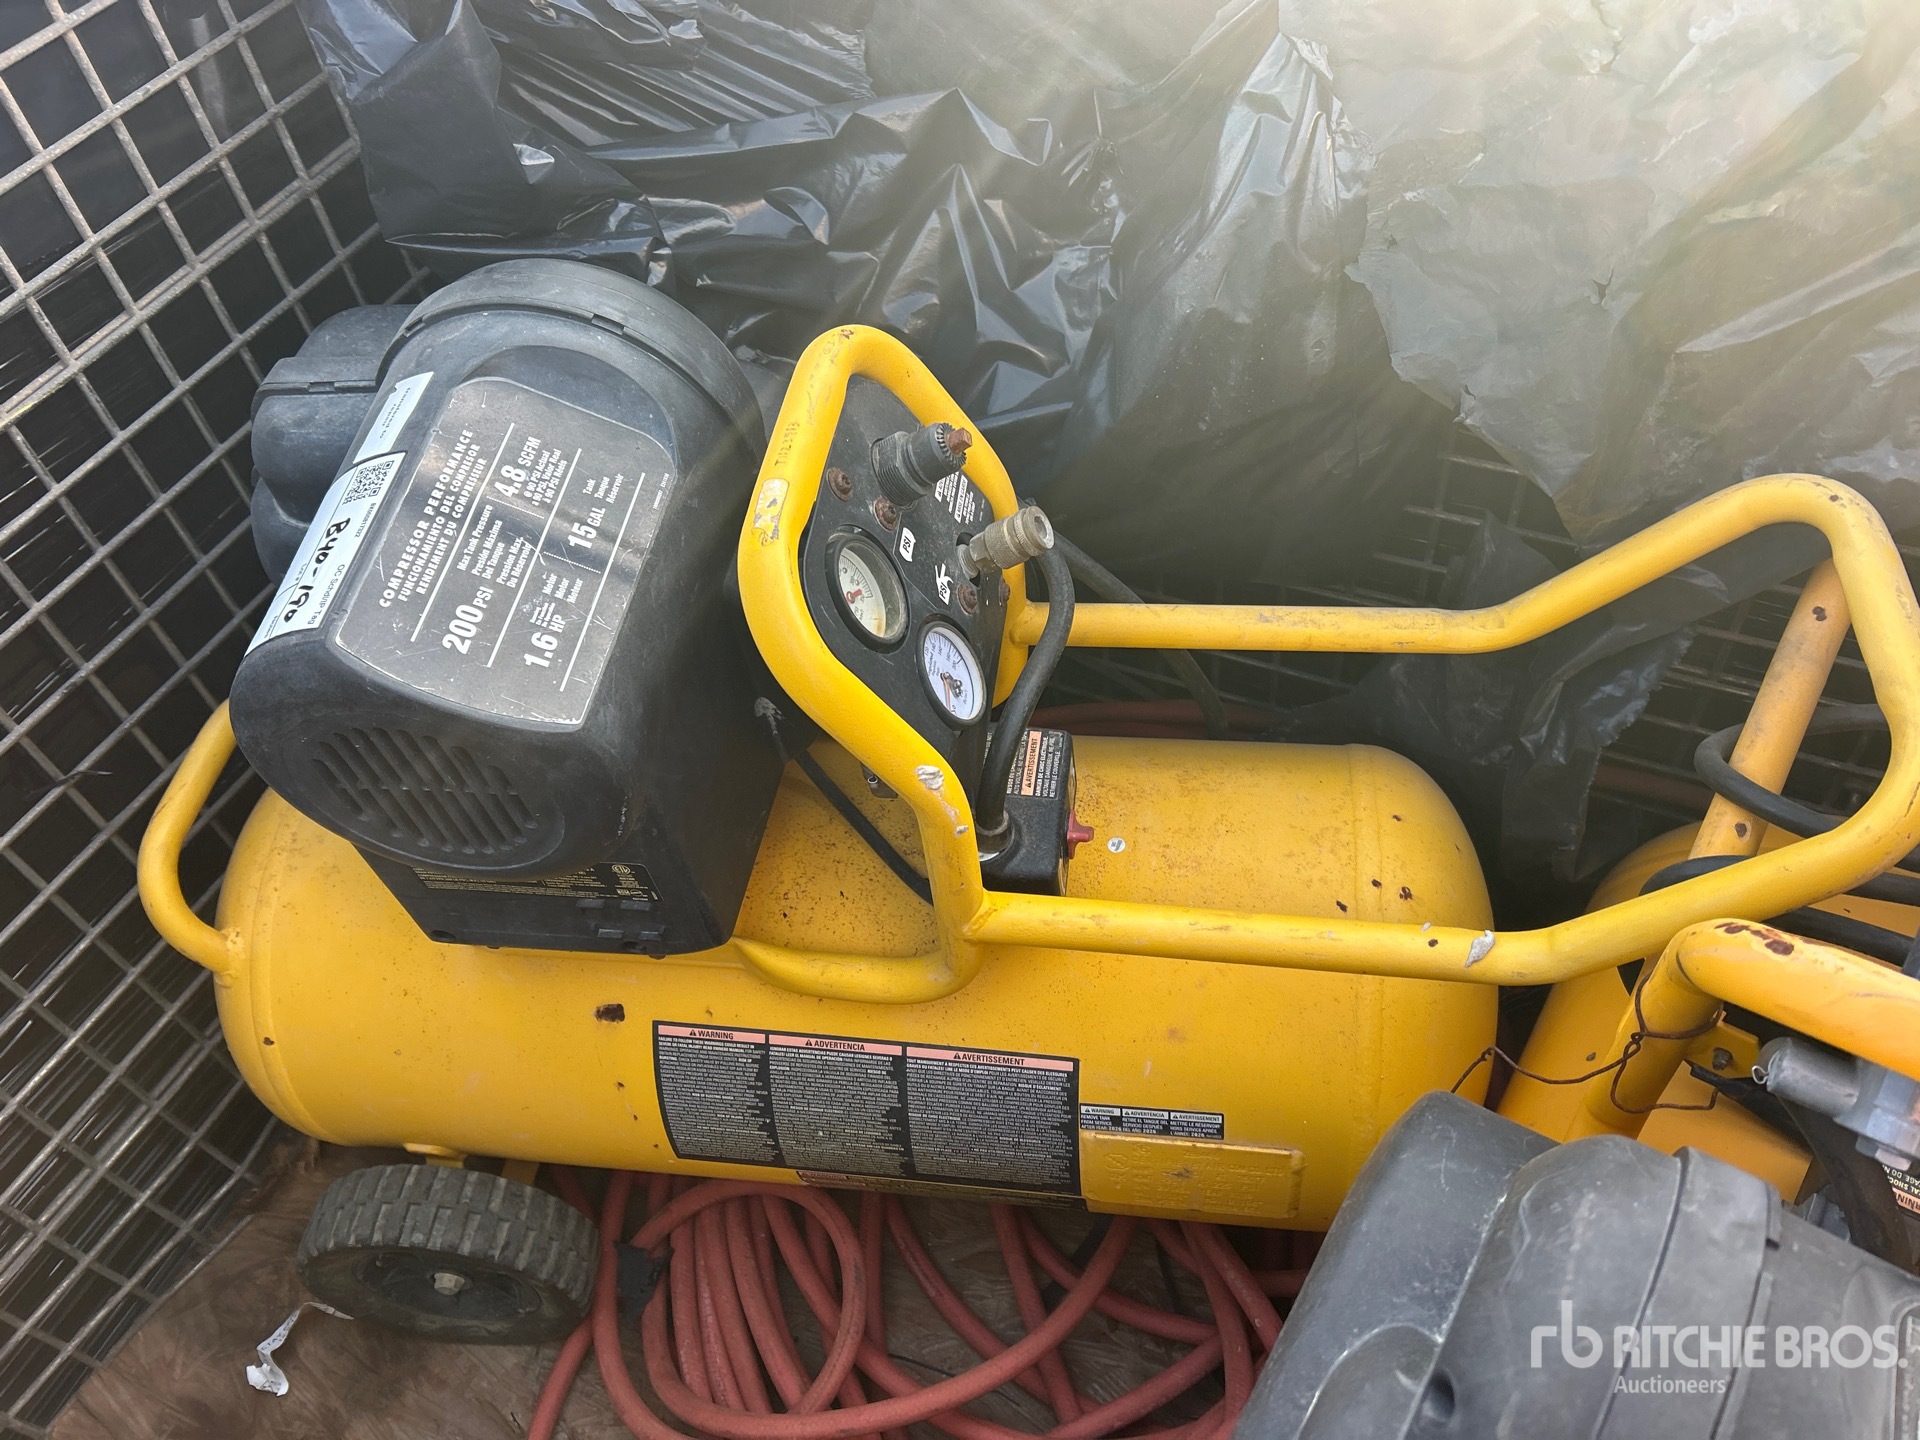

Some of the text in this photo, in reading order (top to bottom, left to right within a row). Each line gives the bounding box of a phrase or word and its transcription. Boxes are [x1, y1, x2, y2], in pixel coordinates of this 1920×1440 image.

[493, 435, 541, 497] 4.8 SCFM
[534, 449, 550, 471] Actual
[530, 469, 541, 482] PSI
[532, 492, 542, 501] 90
[541, 462, 555, 480] Valor
[548, 448, 561, 463] Real
[548, 476, 559, 489] PSI
[526, 481, 536, 491] 90
[544, 488, 555, 498] 90
[582, 478, 596, 494] Tank
[593, 476, 610, 498] Tanque
[605, 473, 625, 503] Réservoir
[379, 429, 473, 607] COMPRESSOR PERFORMANCE
[397, 443, 480, 601] FUNCIONAMIENTO DEL COMPRESOR
[415, 457, 487, 594] RENDEMENT DU COMPRESSEUR
[567, 507, 606, 548] 15 GAL
[456, 504, 493, 570] Max Tank Pressure
[470, 519, 502, 575] Presión Máxima
[902, 536, 912, 553] PSI
[481, 541, 505, 579] Del Tanque
[495, 553, 516, 584] Pression
[506, 576, 518, 588] Du
[541, 572, 557, 594] Motor
[554, 577, 569, 599] Motor
[566, 577, 583, 603] Moteur
[939, 582, 948, 600] PSI
[306, 609, 322, 624] Tag
[441, 585, 494, 654] 200 PSI
[523, 631, 558, 667] 1.6
[548, 614, 567, 632] HP
[1026, 738, 1038, 783] AVERTISSEMENT
[1034, 778, 1042, 796] DANGER
[697, 1029, 734, 1040] WARNING
[813, 1039, 865, 1051] ADVERTENCIA
[961, 1052, 1025, 1066] AVERTISSEMENT
[1130, 1110, 1164, 1118] ADVERTENCIA
[1178, 1113, 1219, 1122] AVERTISSEMENT
